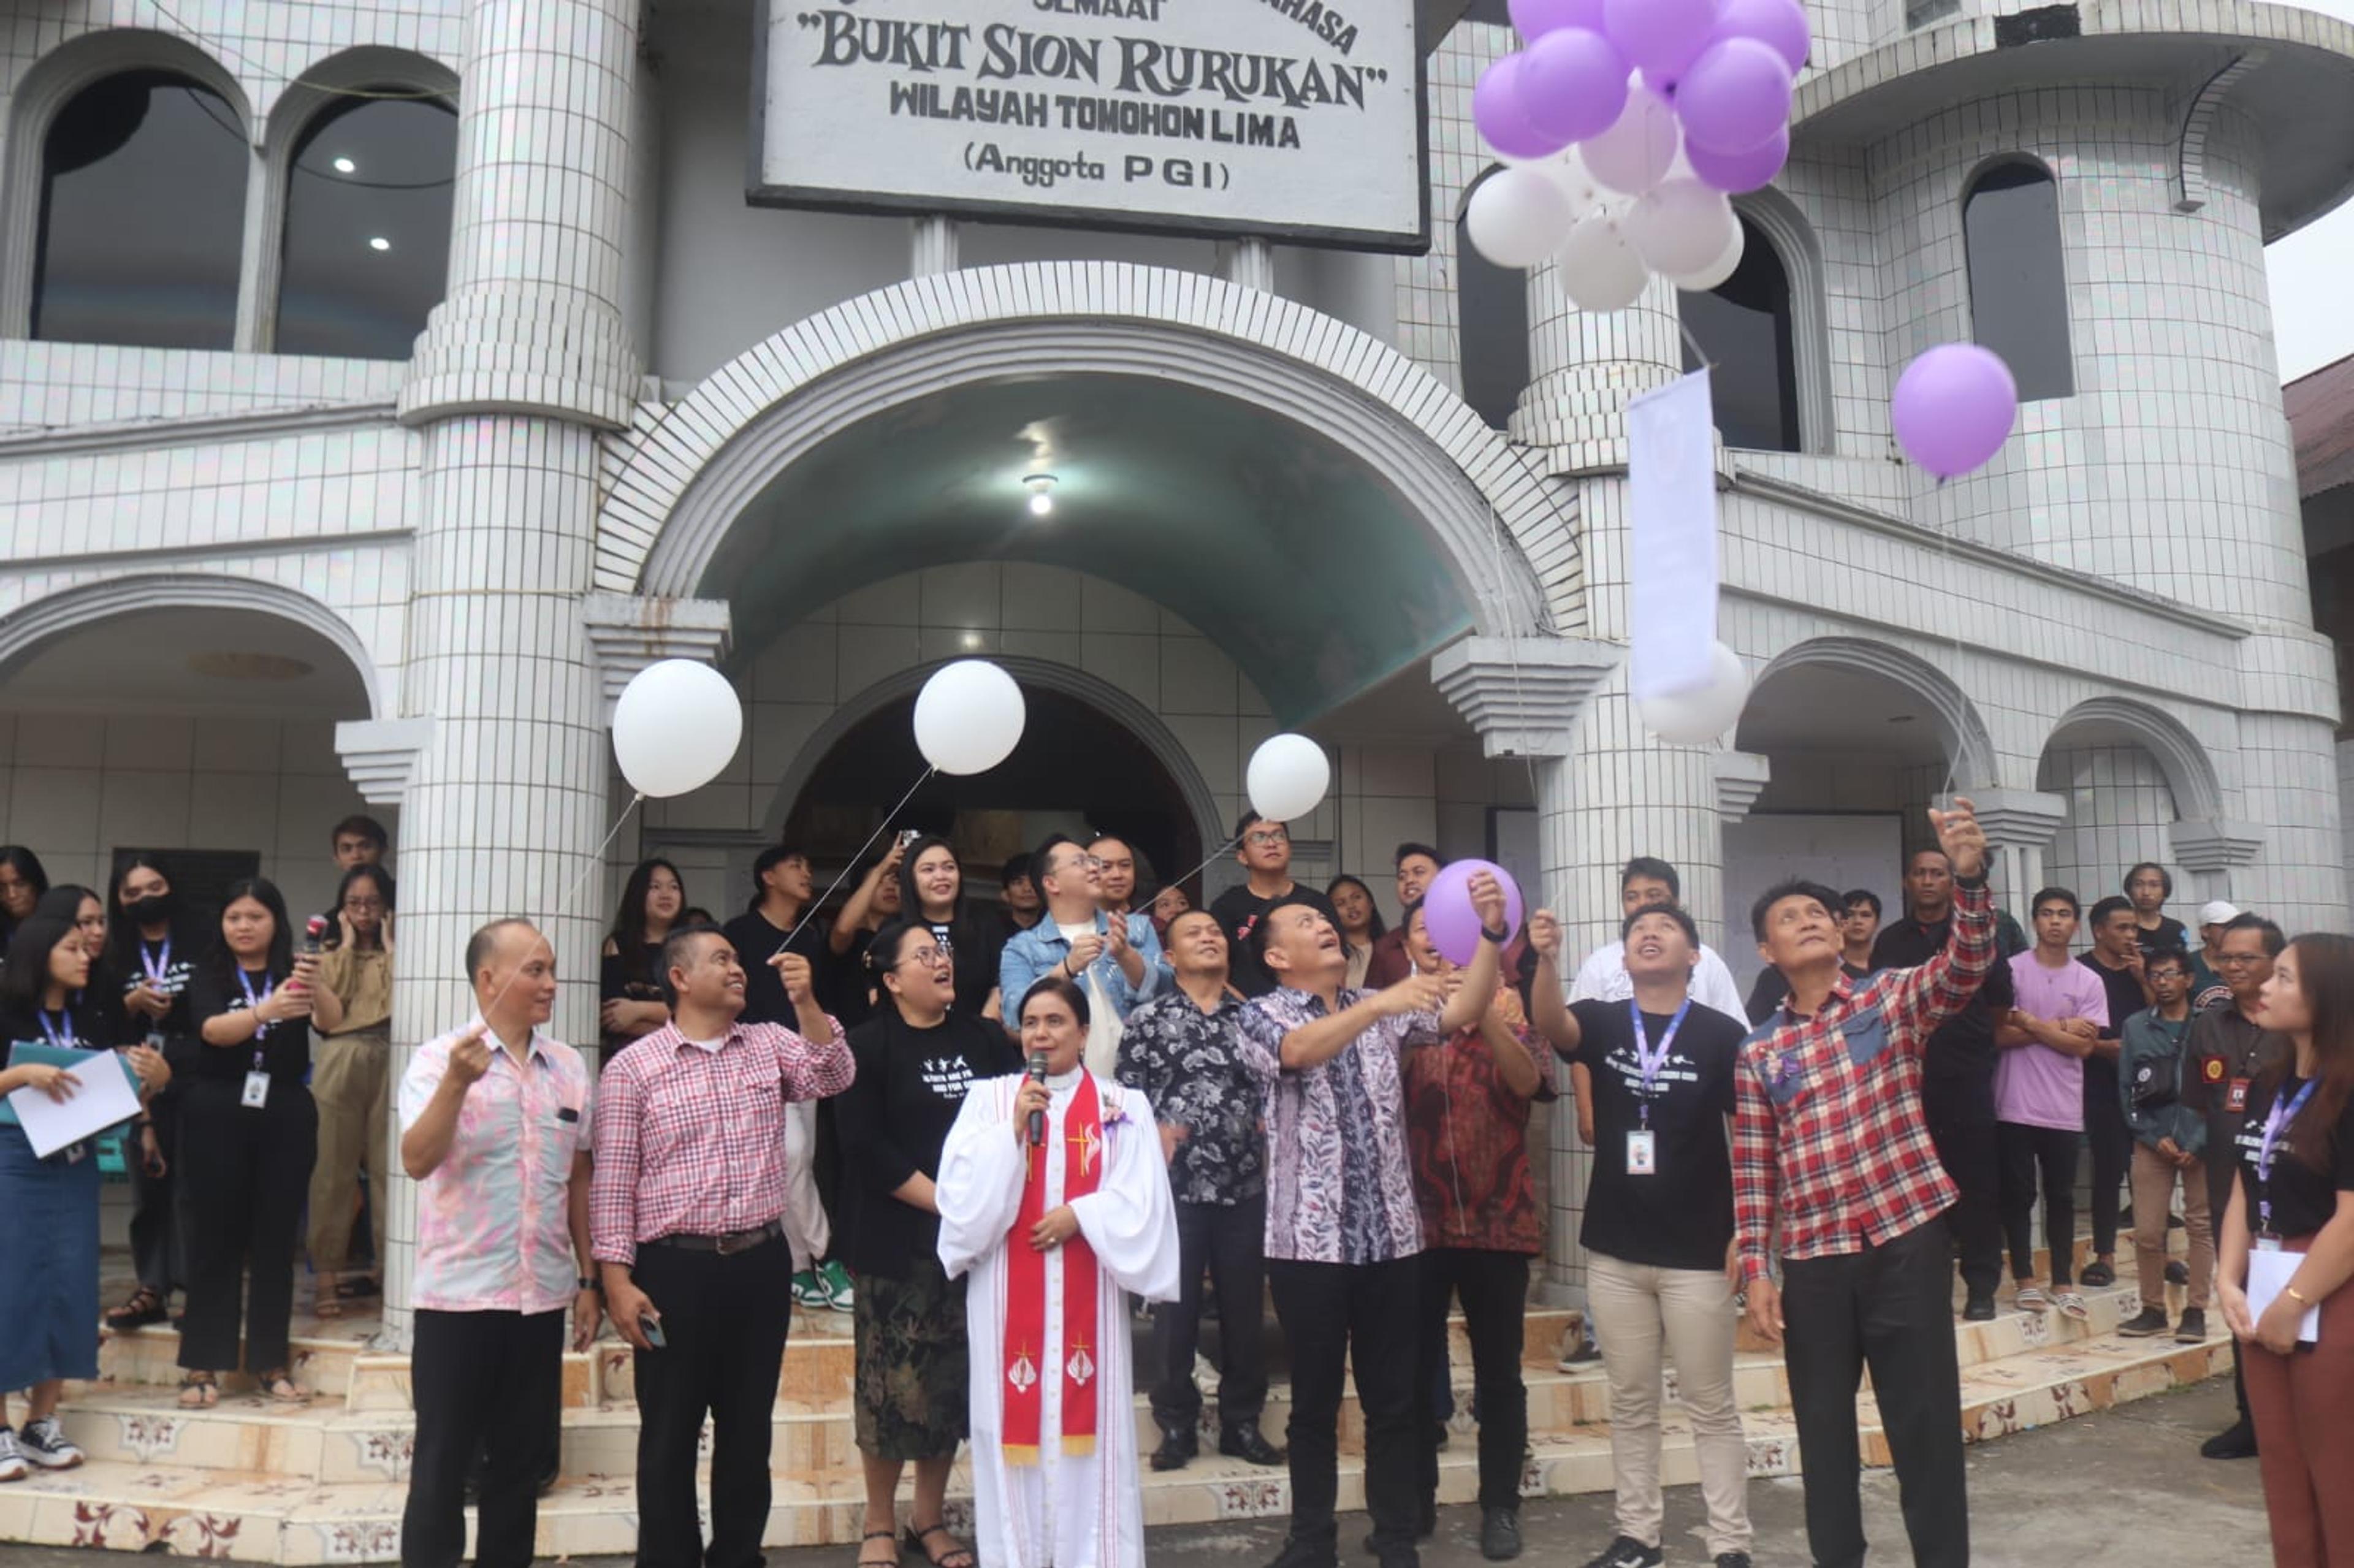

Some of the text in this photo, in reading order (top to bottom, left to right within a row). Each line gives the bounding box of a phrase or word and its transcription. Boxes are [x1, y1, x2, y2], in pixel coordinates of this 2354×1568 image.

[976, 23, 1102, 85] SION
[890, 81, 1300, 149] WILAYAH TOMOHON LIMA
[964, 141, 1105, 187] (Anggota
